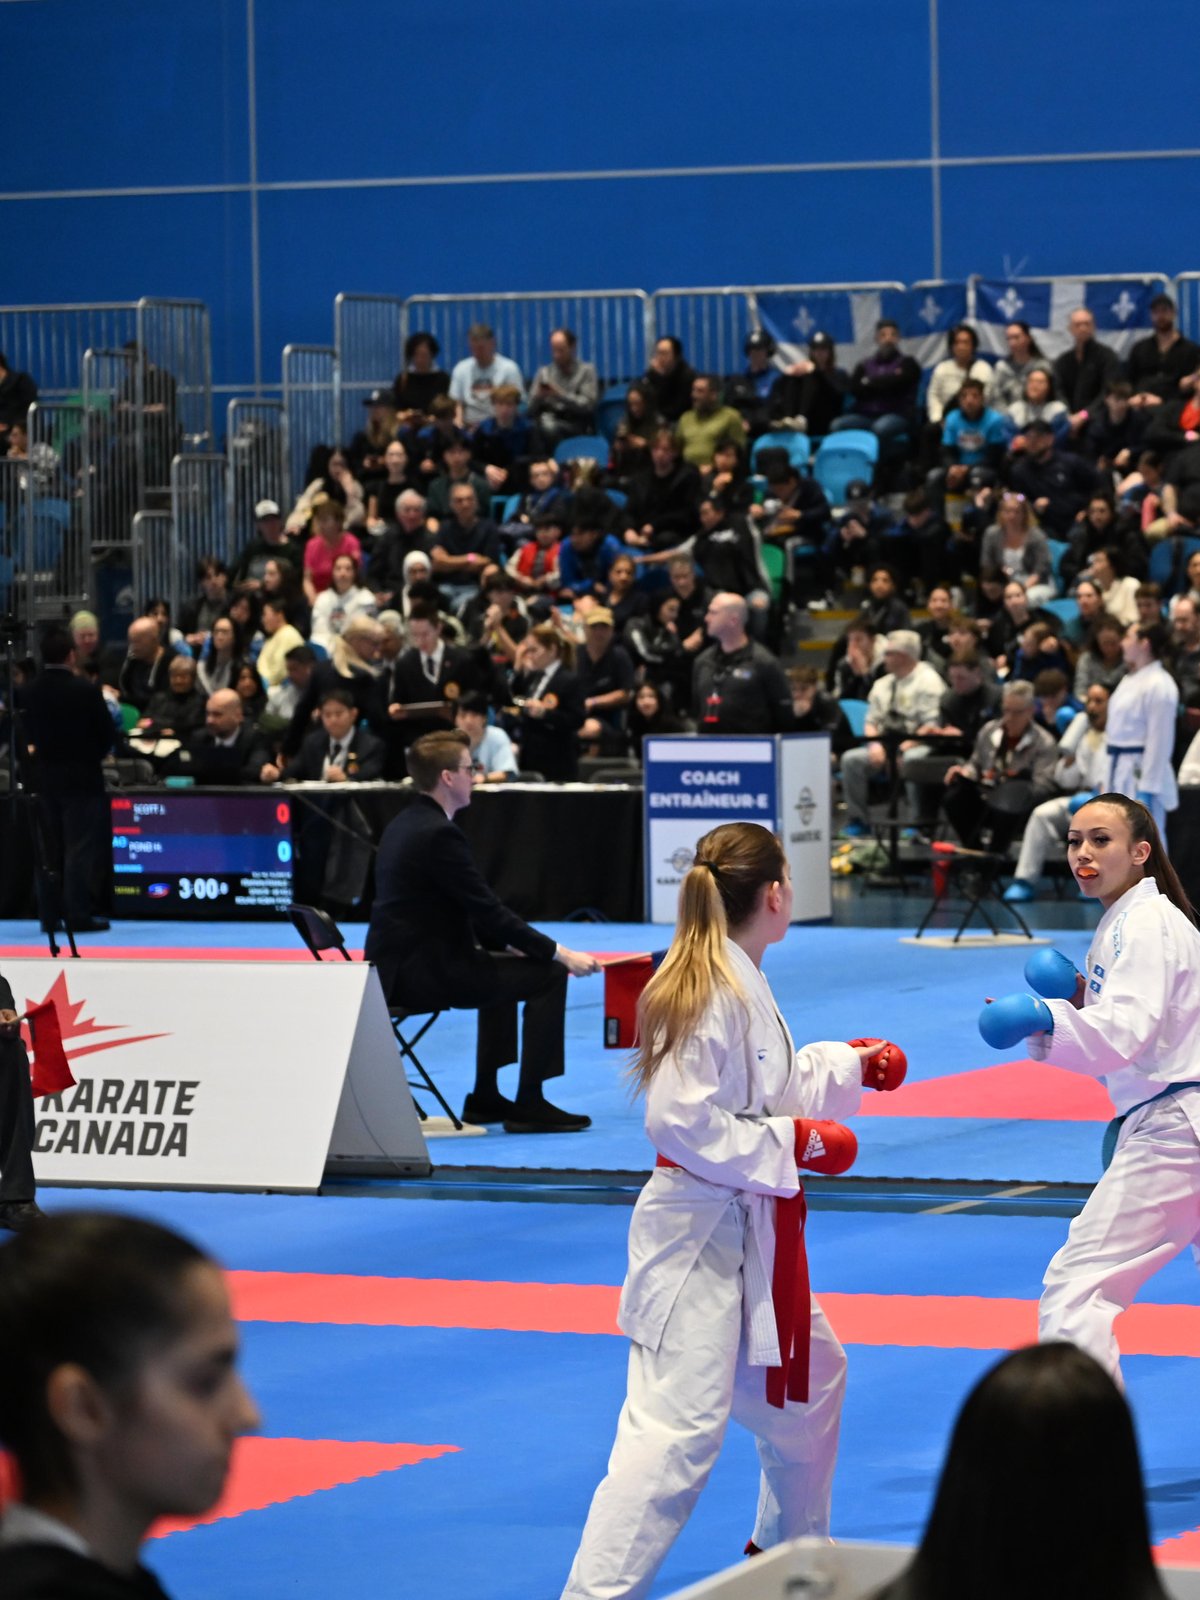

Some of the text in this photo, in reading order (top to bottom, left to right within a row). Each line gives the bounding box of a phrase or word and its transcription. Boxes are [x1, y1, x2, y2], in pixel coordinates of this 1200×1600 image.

[681, 770, 740, 786] COACH
[277, 802, 290, 824] 0
[278, 840, 292, 862] 0
[31, 1119, 188, 1157] CANADA
[802, 1128, 818, 1162] adidas
